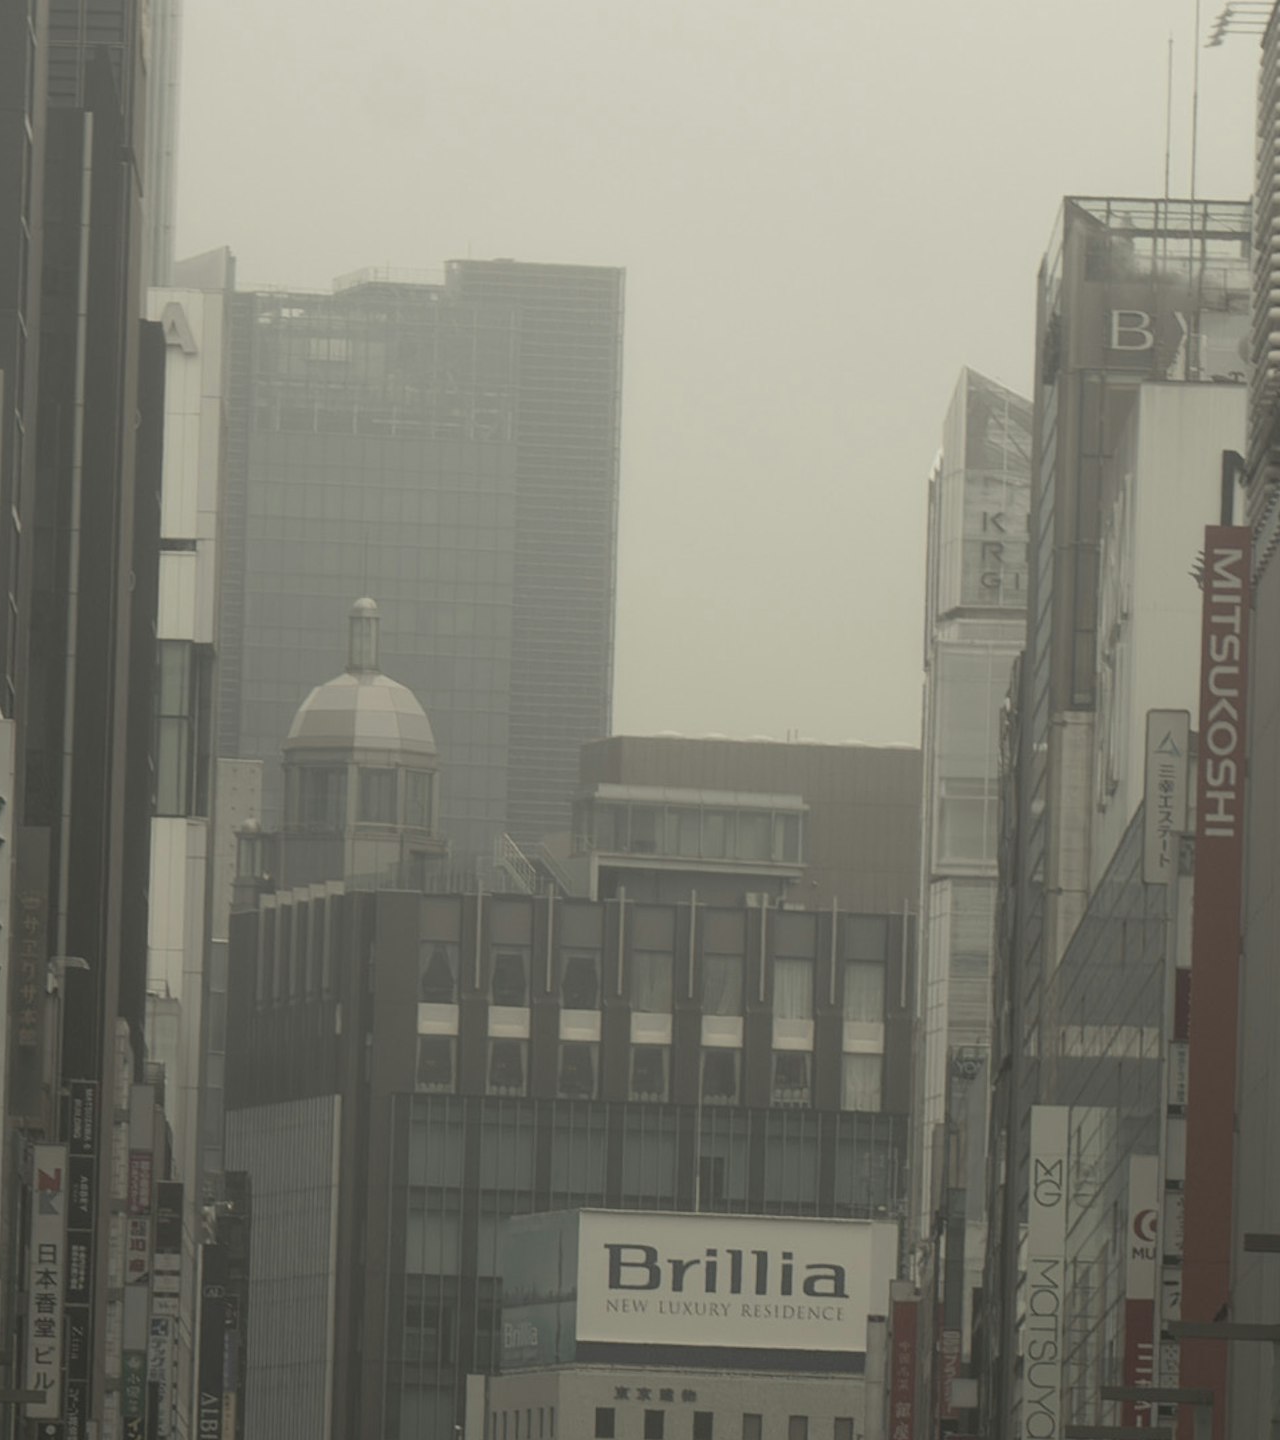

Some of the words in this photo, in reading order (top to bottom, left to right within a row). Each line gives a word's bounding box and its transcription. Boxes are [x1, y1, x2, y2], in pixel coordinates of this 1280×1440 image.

[1204, 547, 1244, 838] MITSUKOSHI
[33, 1243, 58, 1390] 日本香堂ビル
[604, 1242, 850, 1299] Brillia
[606, 1298, 649, 1314] NEW
[658, 1299, 732, 1319] LUXURY
[740, 1303, 845, 1321] RESIDENCE
